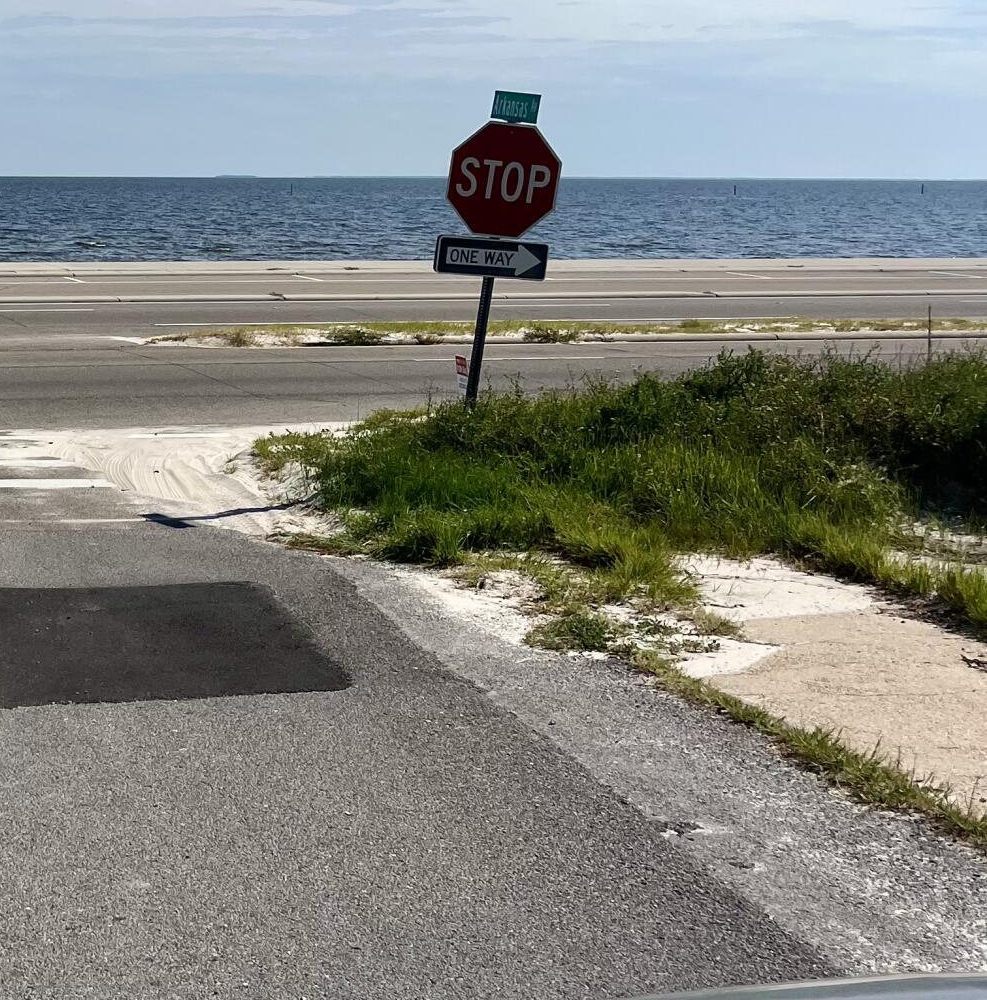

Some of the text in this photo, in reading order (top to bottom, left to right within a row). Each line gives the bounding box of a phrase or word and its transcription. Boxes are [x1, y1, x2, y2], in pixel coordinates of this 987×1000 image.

[493, 94, 528, 118] Arkansas
[456, 156, 551, 204] STOP
[450, 248, 514, 266] ONE WAY
